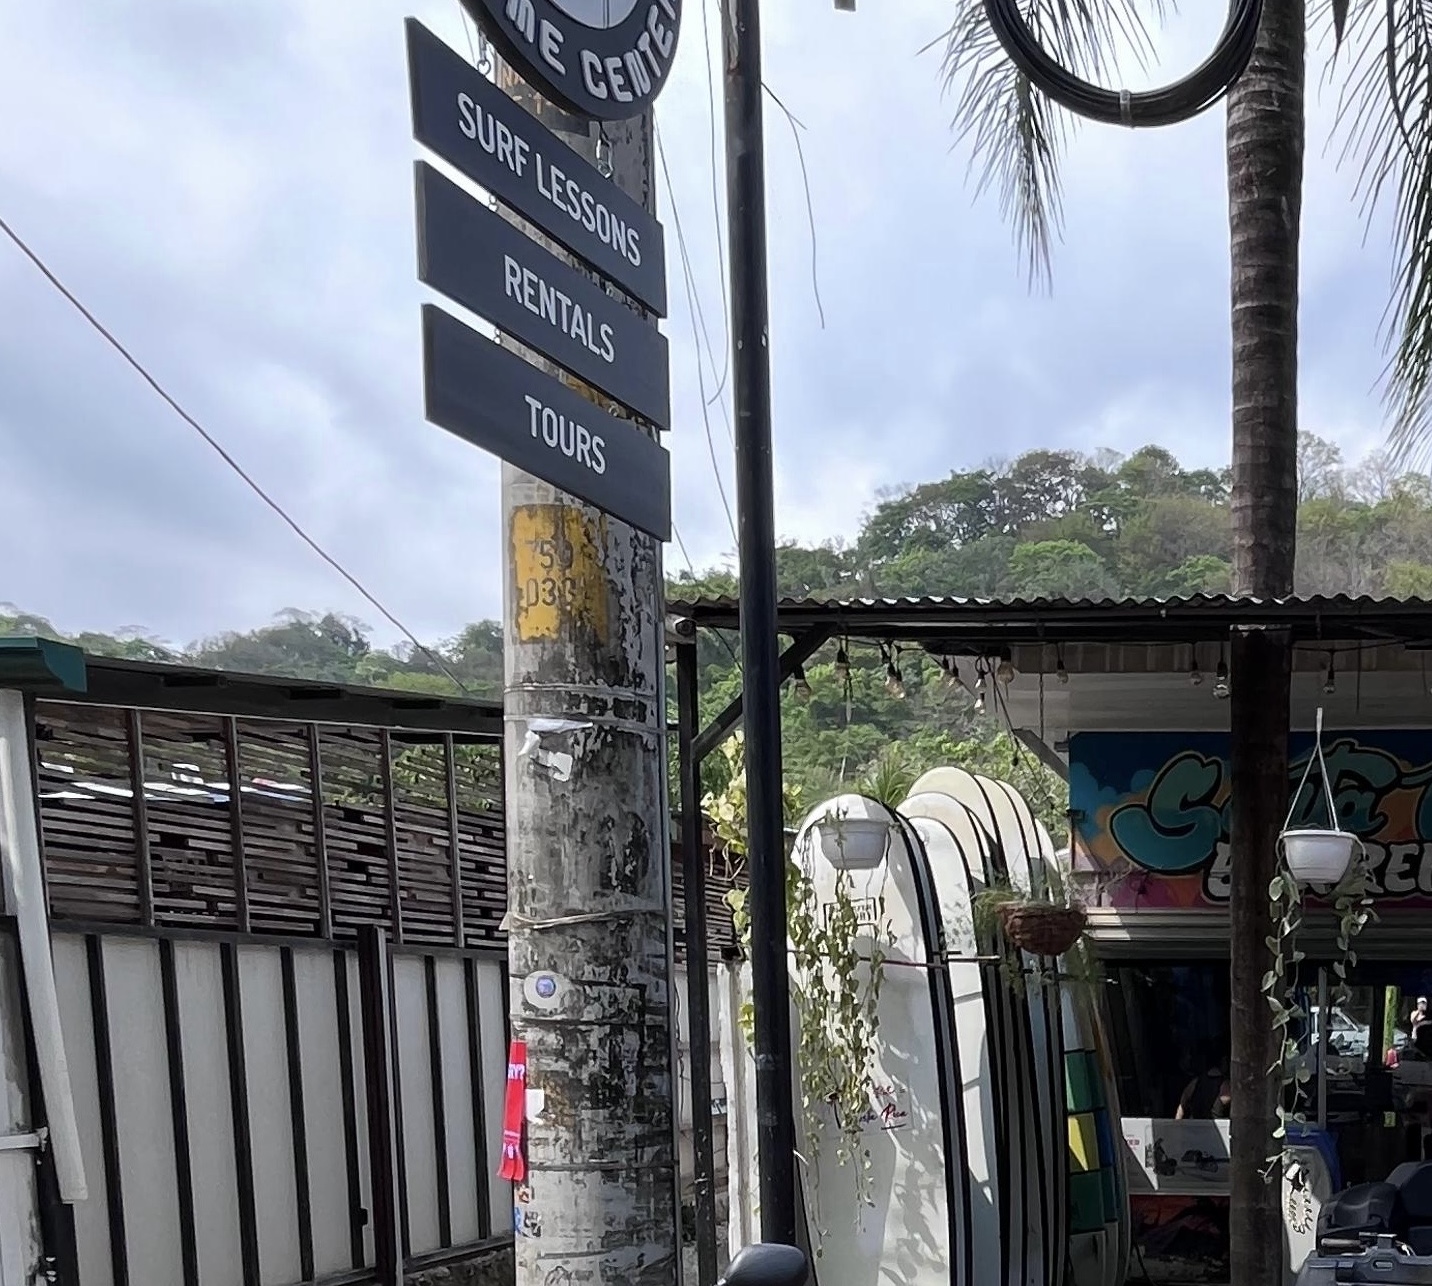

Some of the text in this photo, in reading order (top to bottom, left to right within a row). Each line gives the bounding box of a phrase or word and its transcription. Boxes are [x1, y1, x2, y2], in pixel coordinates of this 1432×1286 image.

[457, 92, 641, 267] SURF LESSONS
[504, 254, 616, 363] RENTALS
[525, 395, 607, 475] TOURS
